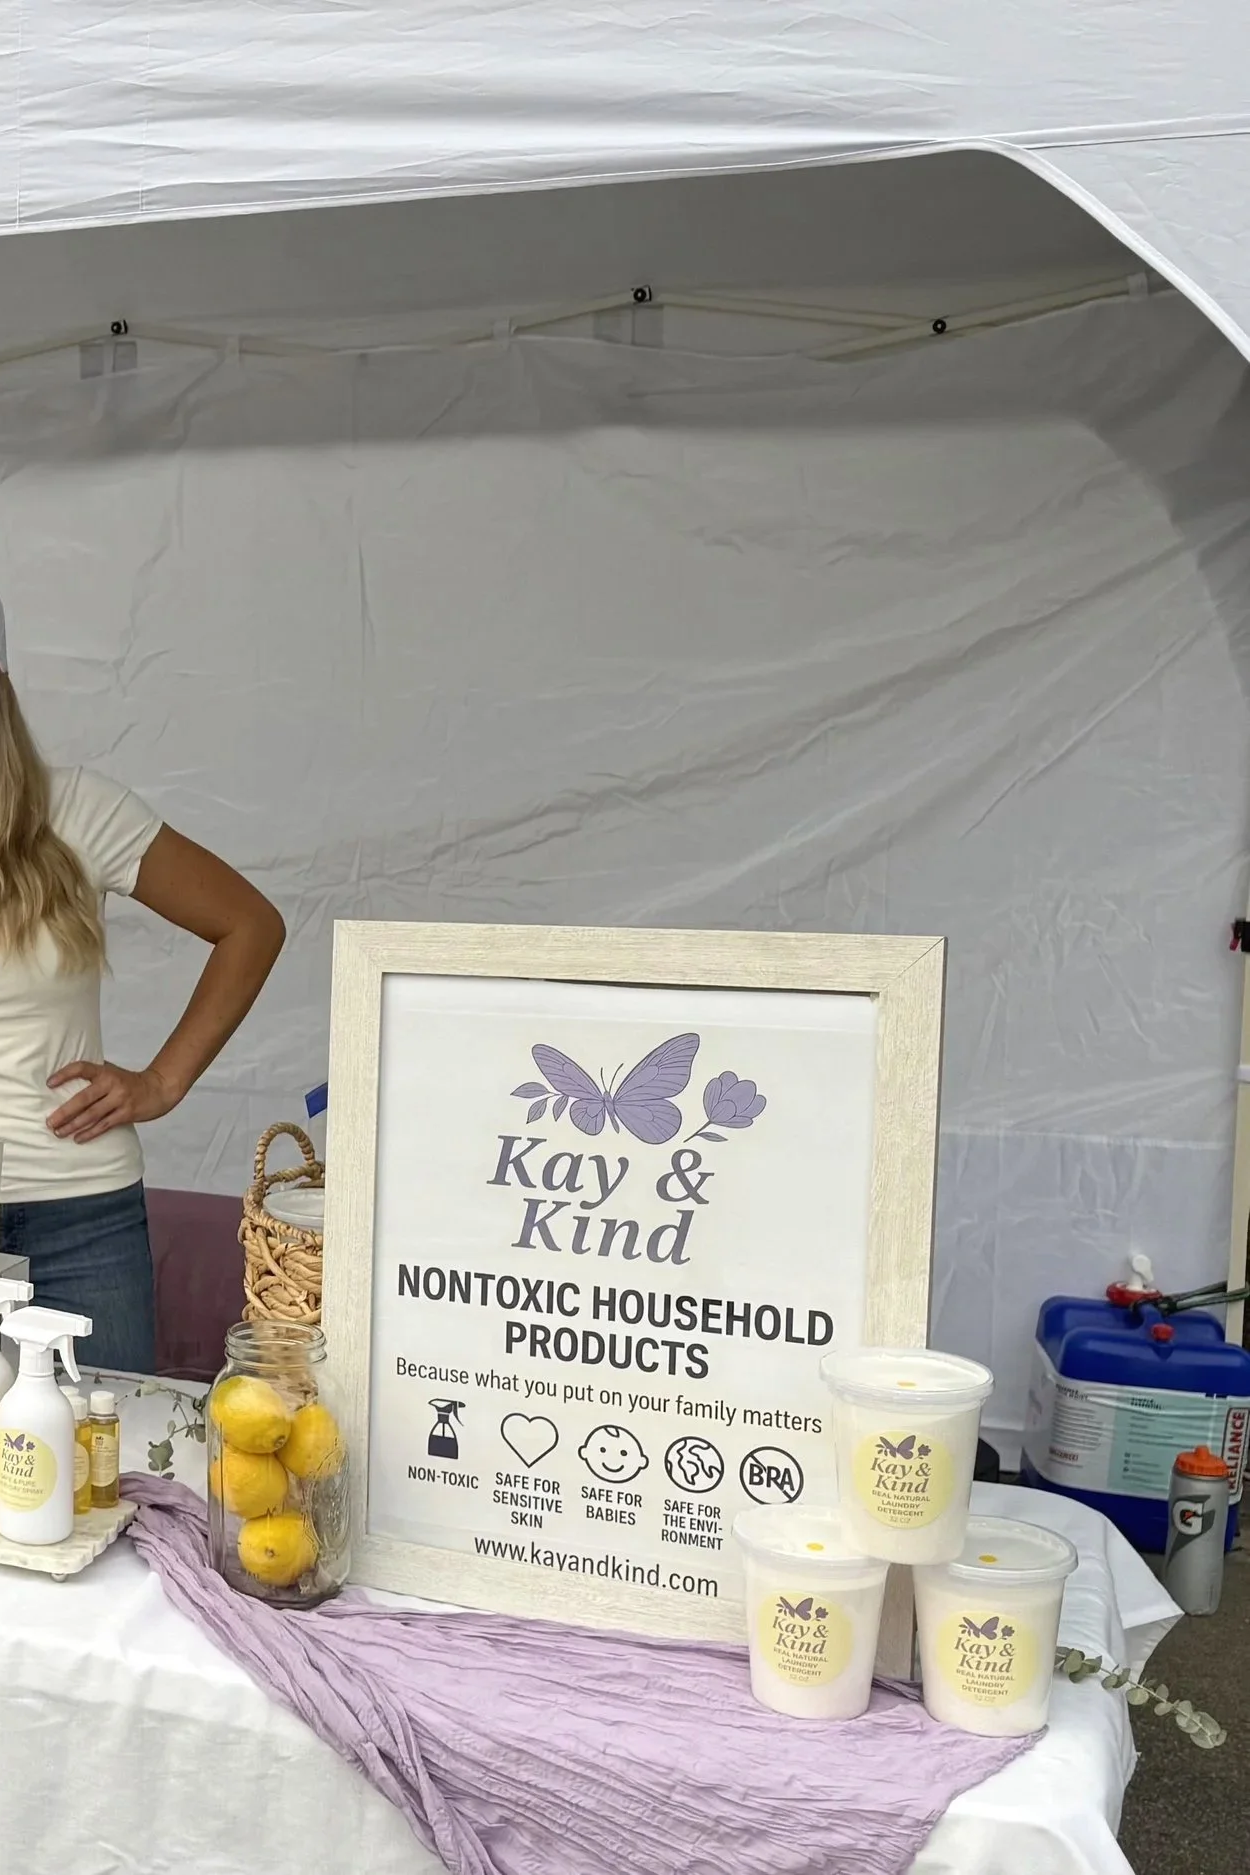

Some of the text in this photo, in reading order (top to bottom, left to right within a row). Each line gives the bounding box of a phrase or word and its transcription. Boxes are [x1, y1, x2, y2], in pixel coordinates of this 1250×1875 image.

[486, 1134, 715, 1210] Kay &
[511, 1197, 695, 1265] Kind
[397, 1263, 834, 1347] NONTOXIC HOUSEHOLD
[505, 1321, 710, 1380] PRODUCTS
[396, 1358, 823, 1434] Because what you put on your family matters
[1, 1447, 35, 1466] Kay &
[3, 1461, 34, 1478] Kind
[407, 1466, 479, 1490] NON-TOXIC
[870, 1457, 932, 1480] Kay &
[495, 1472, 561, 1495] SAFE FOR
[875, 1474, 929, 1493] Kind
[492, 1489, 563, 1514] SENSITIVE
[580, 1486, 643, 1508] SAFE FOR
[871, 1489, 931, 1502] REAL NATURAL
[881, 1499, 921, 1509] LAUNDRY
[510, 1510, 544, 1529] SKIN
[585, 1505, 637, 1526] BABIES
[664, 1499, 722, 1520] SAFE FOR
[877, 1506, 924, 1517] DETERGENT
[663, 1514, 723, 1535] THE ENVI-
[660, 1528, 724, 1551] RONMENT
[474, 1537, 719, 1597] www.kayandkind.com
[772, 1616, 829, 1639] Kay &
[776, 1633, 827, 1654] Kind
[954, 1636, 1016, 1660] Kay &
[781, 1657, 819, 1669] LAUNDRY
[792, 1652, 829, 1663] NATURAL
[959, 1654, 1014, 1673] Kind
[777, 1663, 822, 1677] DETERGENT
[956, 1668, 1015, 1681] REAL NATURAL
[961, 1684, 1009, 1696] DETERGENT
[966, 1679, 1005, 1688] LAUNDRY
